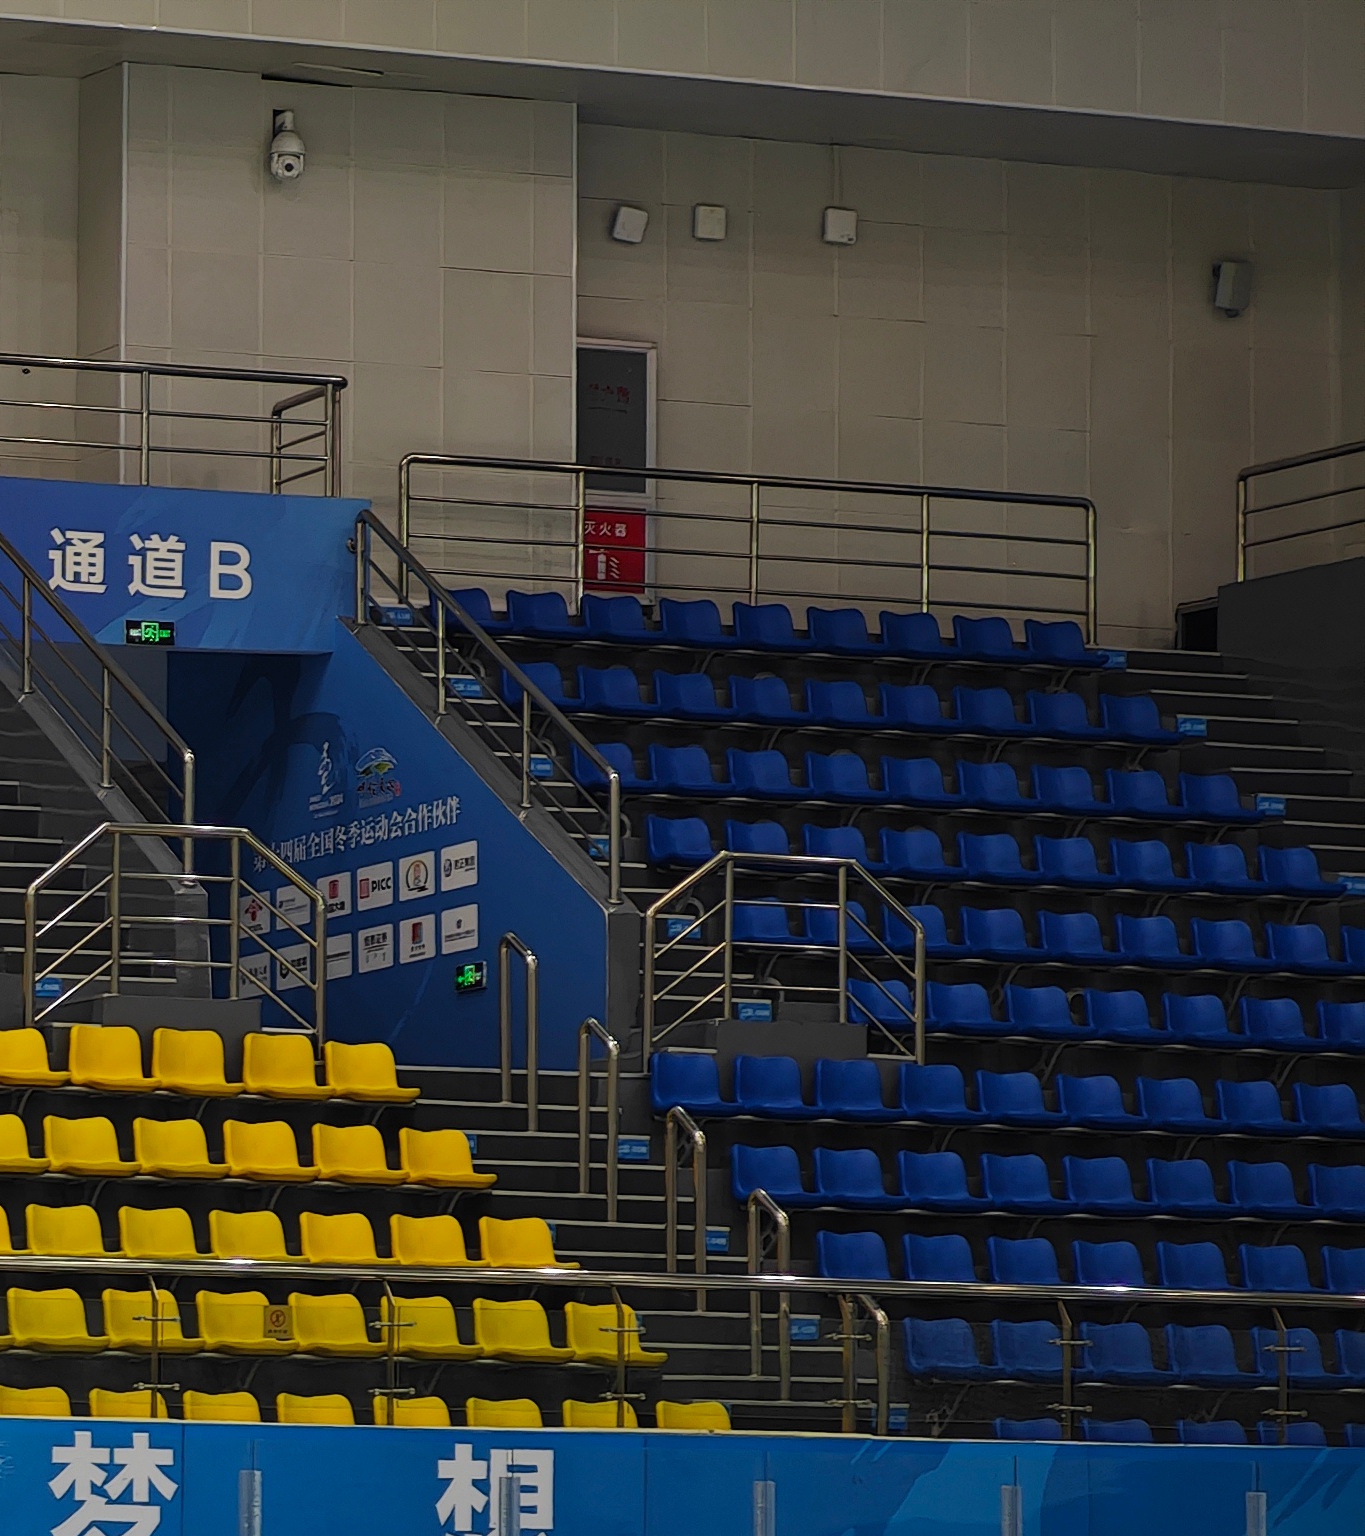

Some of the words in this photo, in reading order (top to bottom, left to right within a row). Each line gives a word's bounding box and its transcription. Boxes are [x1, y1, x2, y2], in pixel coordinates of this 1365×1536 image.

[584, 521, 627, 538] 灭火器
[48, 527, 253, 600] 通道B
[371, 876, 392, 893] PICC
